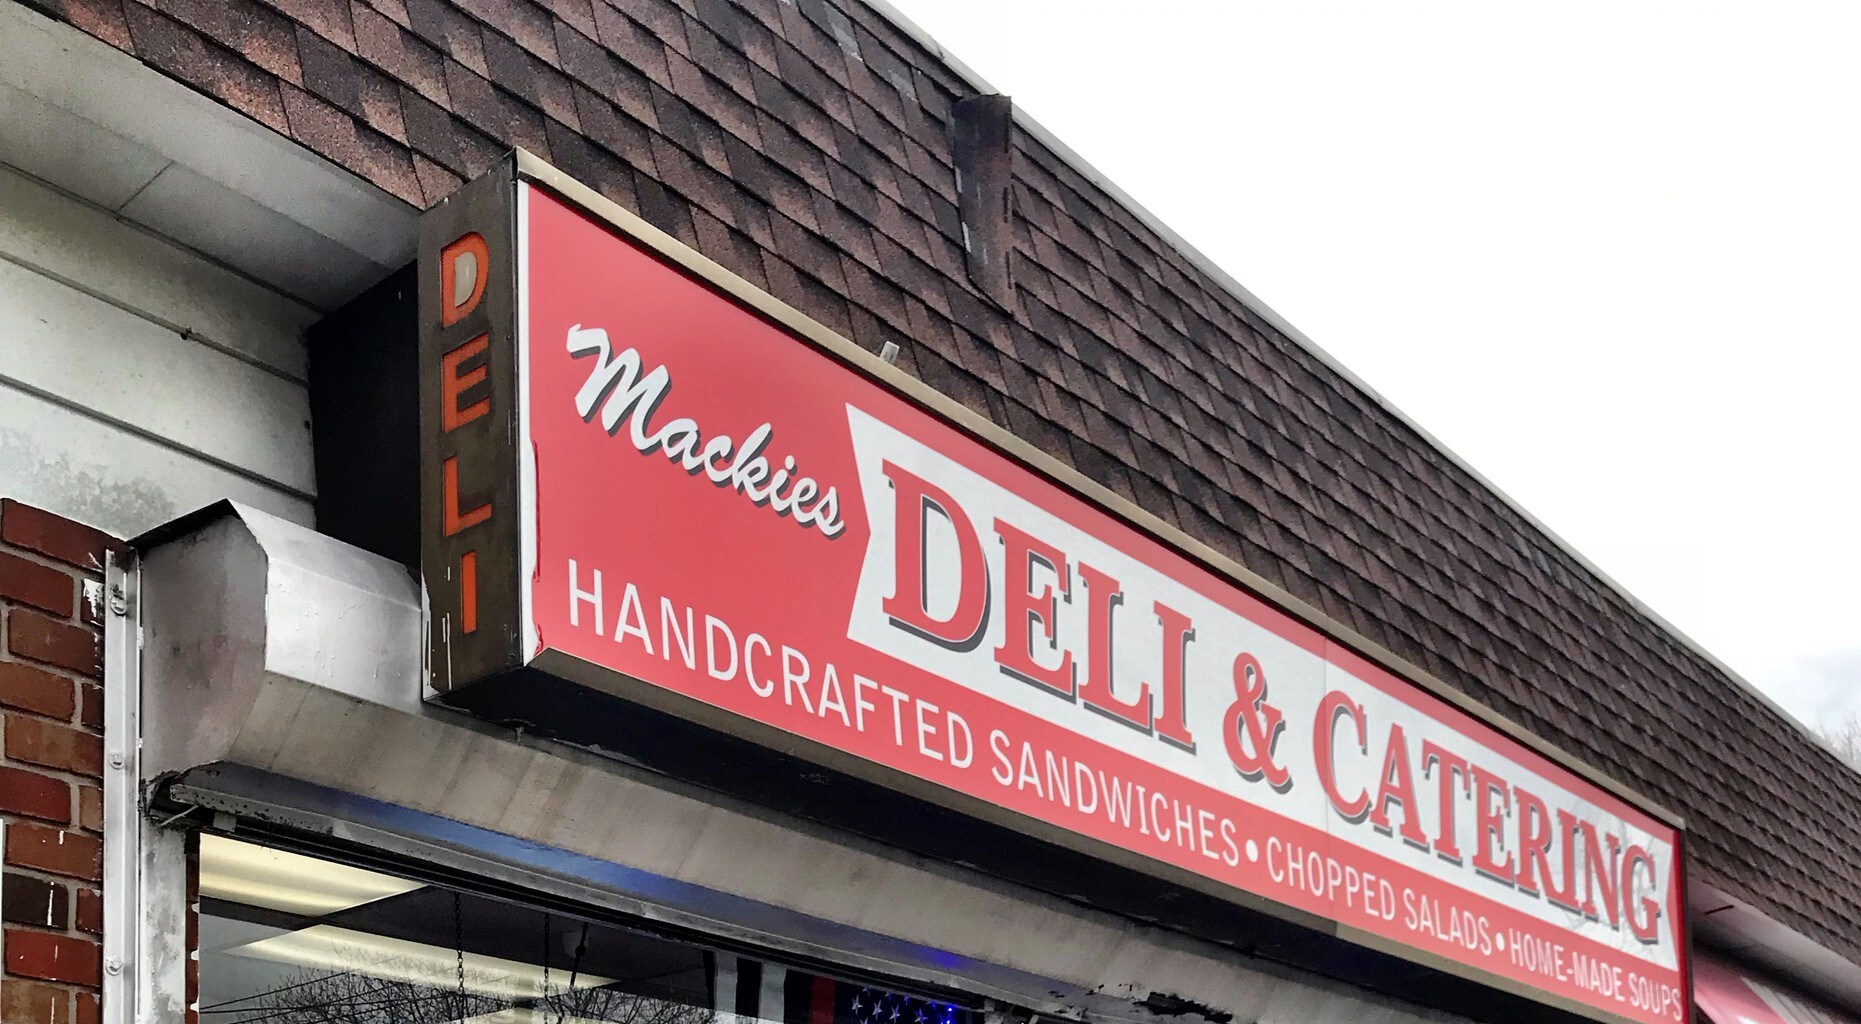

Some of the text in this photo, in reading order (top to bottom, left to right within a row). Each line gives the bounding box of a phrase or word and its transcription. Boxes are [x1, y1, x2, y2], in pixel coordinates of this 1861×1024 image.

[440, 231, 493, 635] DELI
[566, 322, 845, 540] Mackies
[568, 558, 974, 770] HANDCRAFTED
[989, 728, 1240, 868] SANDWICHES
[1266, 836, 1396, 921] CHOPPED
[1404, 888, 1493, 957] SALADS
[1509, 926, 1626, 1003] HOME-MADE
[1628, 972, 1683, 1023] SOUPS
[881, 459, 1661, 945] DELI & CATERING
